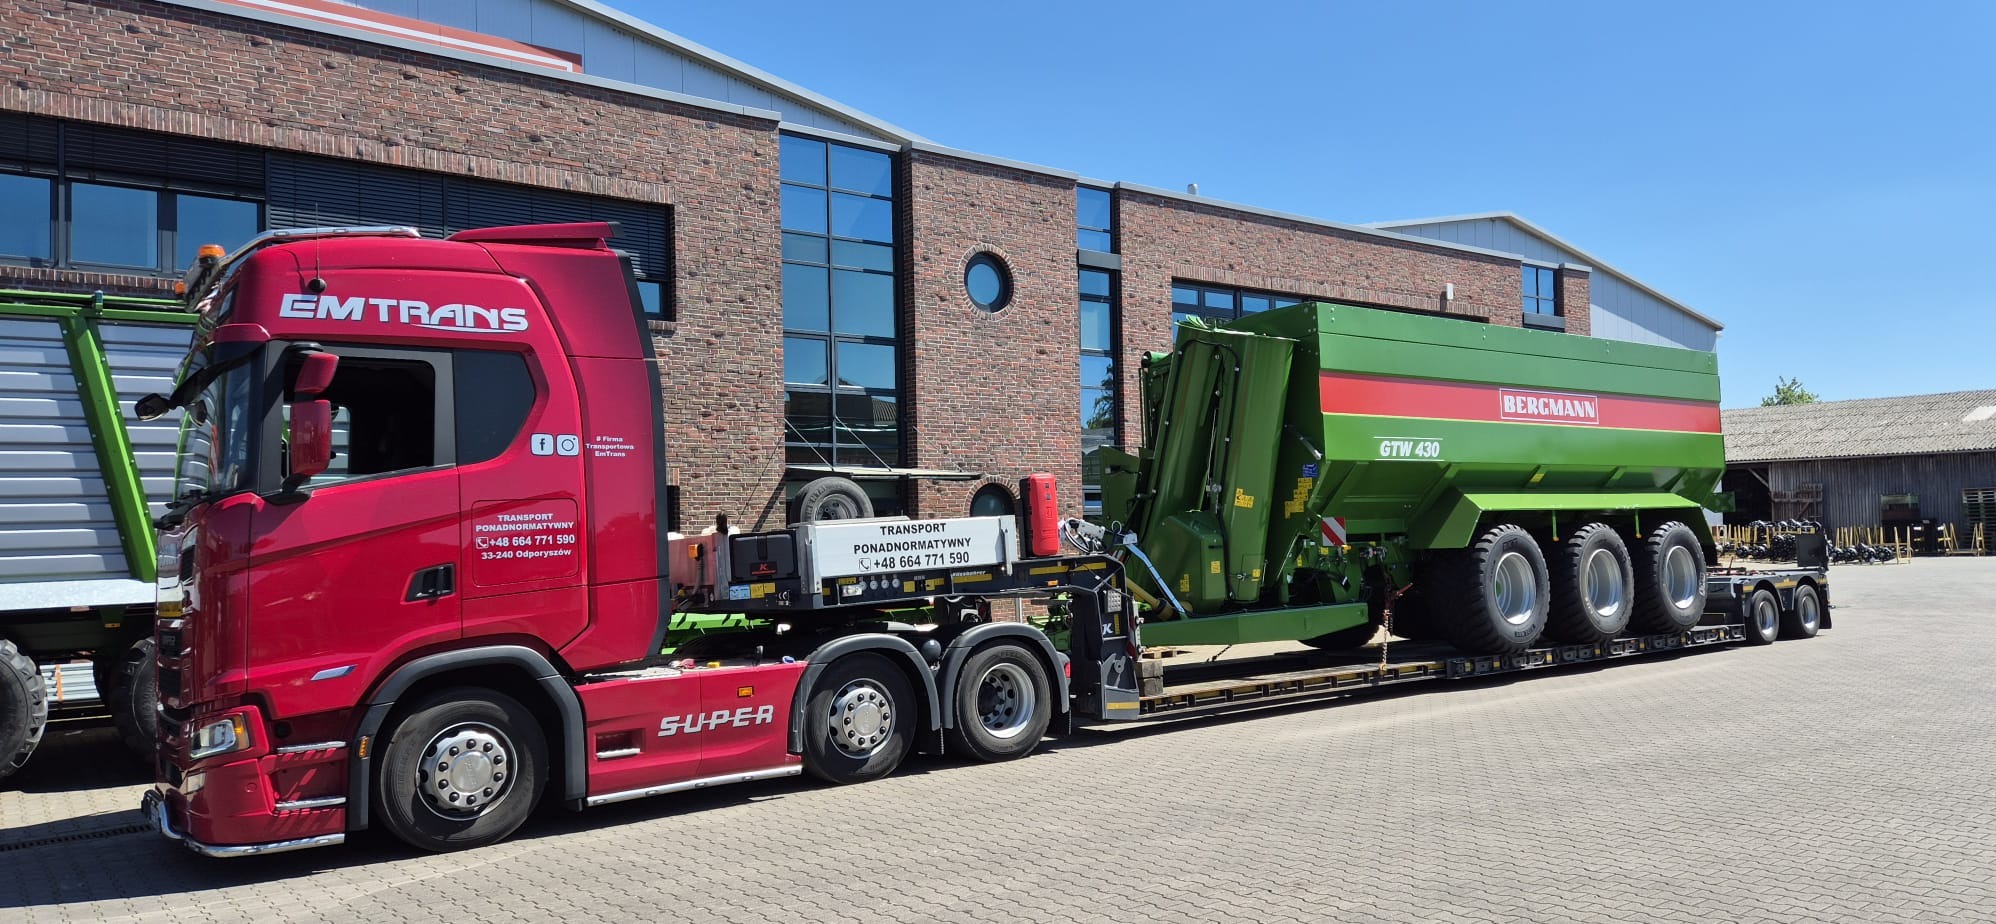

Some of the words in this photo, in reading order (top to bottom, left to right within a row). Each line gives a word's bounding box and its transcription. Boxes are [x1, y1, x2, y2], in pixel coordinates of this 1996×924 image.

[1503, 395, 1595, 418] BERGMANN
[1379, 441, 1413, 457] GTW
[1415, 441, 1440, 457] 430
[497, 513, 553, 522] TRANSPORT
[475, 522, 574, 532] PONADNORMATYWNY
[880, 523, 947, 536] TRANSPORT
[489, 537, 510, 547] +48
[512, 536, 532, 546] 664
[534, 535, 553, 545] 771
[556, 534, 575, 544] 590
[853, 537, 972, 555] PONADNORMATYWNY
[481, 551, 513, 560] 33-240
[515, 549, 572, 559] Odporyszów
[873, 556, 896, 569] +48
[899, 555, 922, 568] 664
[925, 553, 945, 566] 771
[950, 551, 970, 565] 590
[657, 705, 774, 736] SUPER
